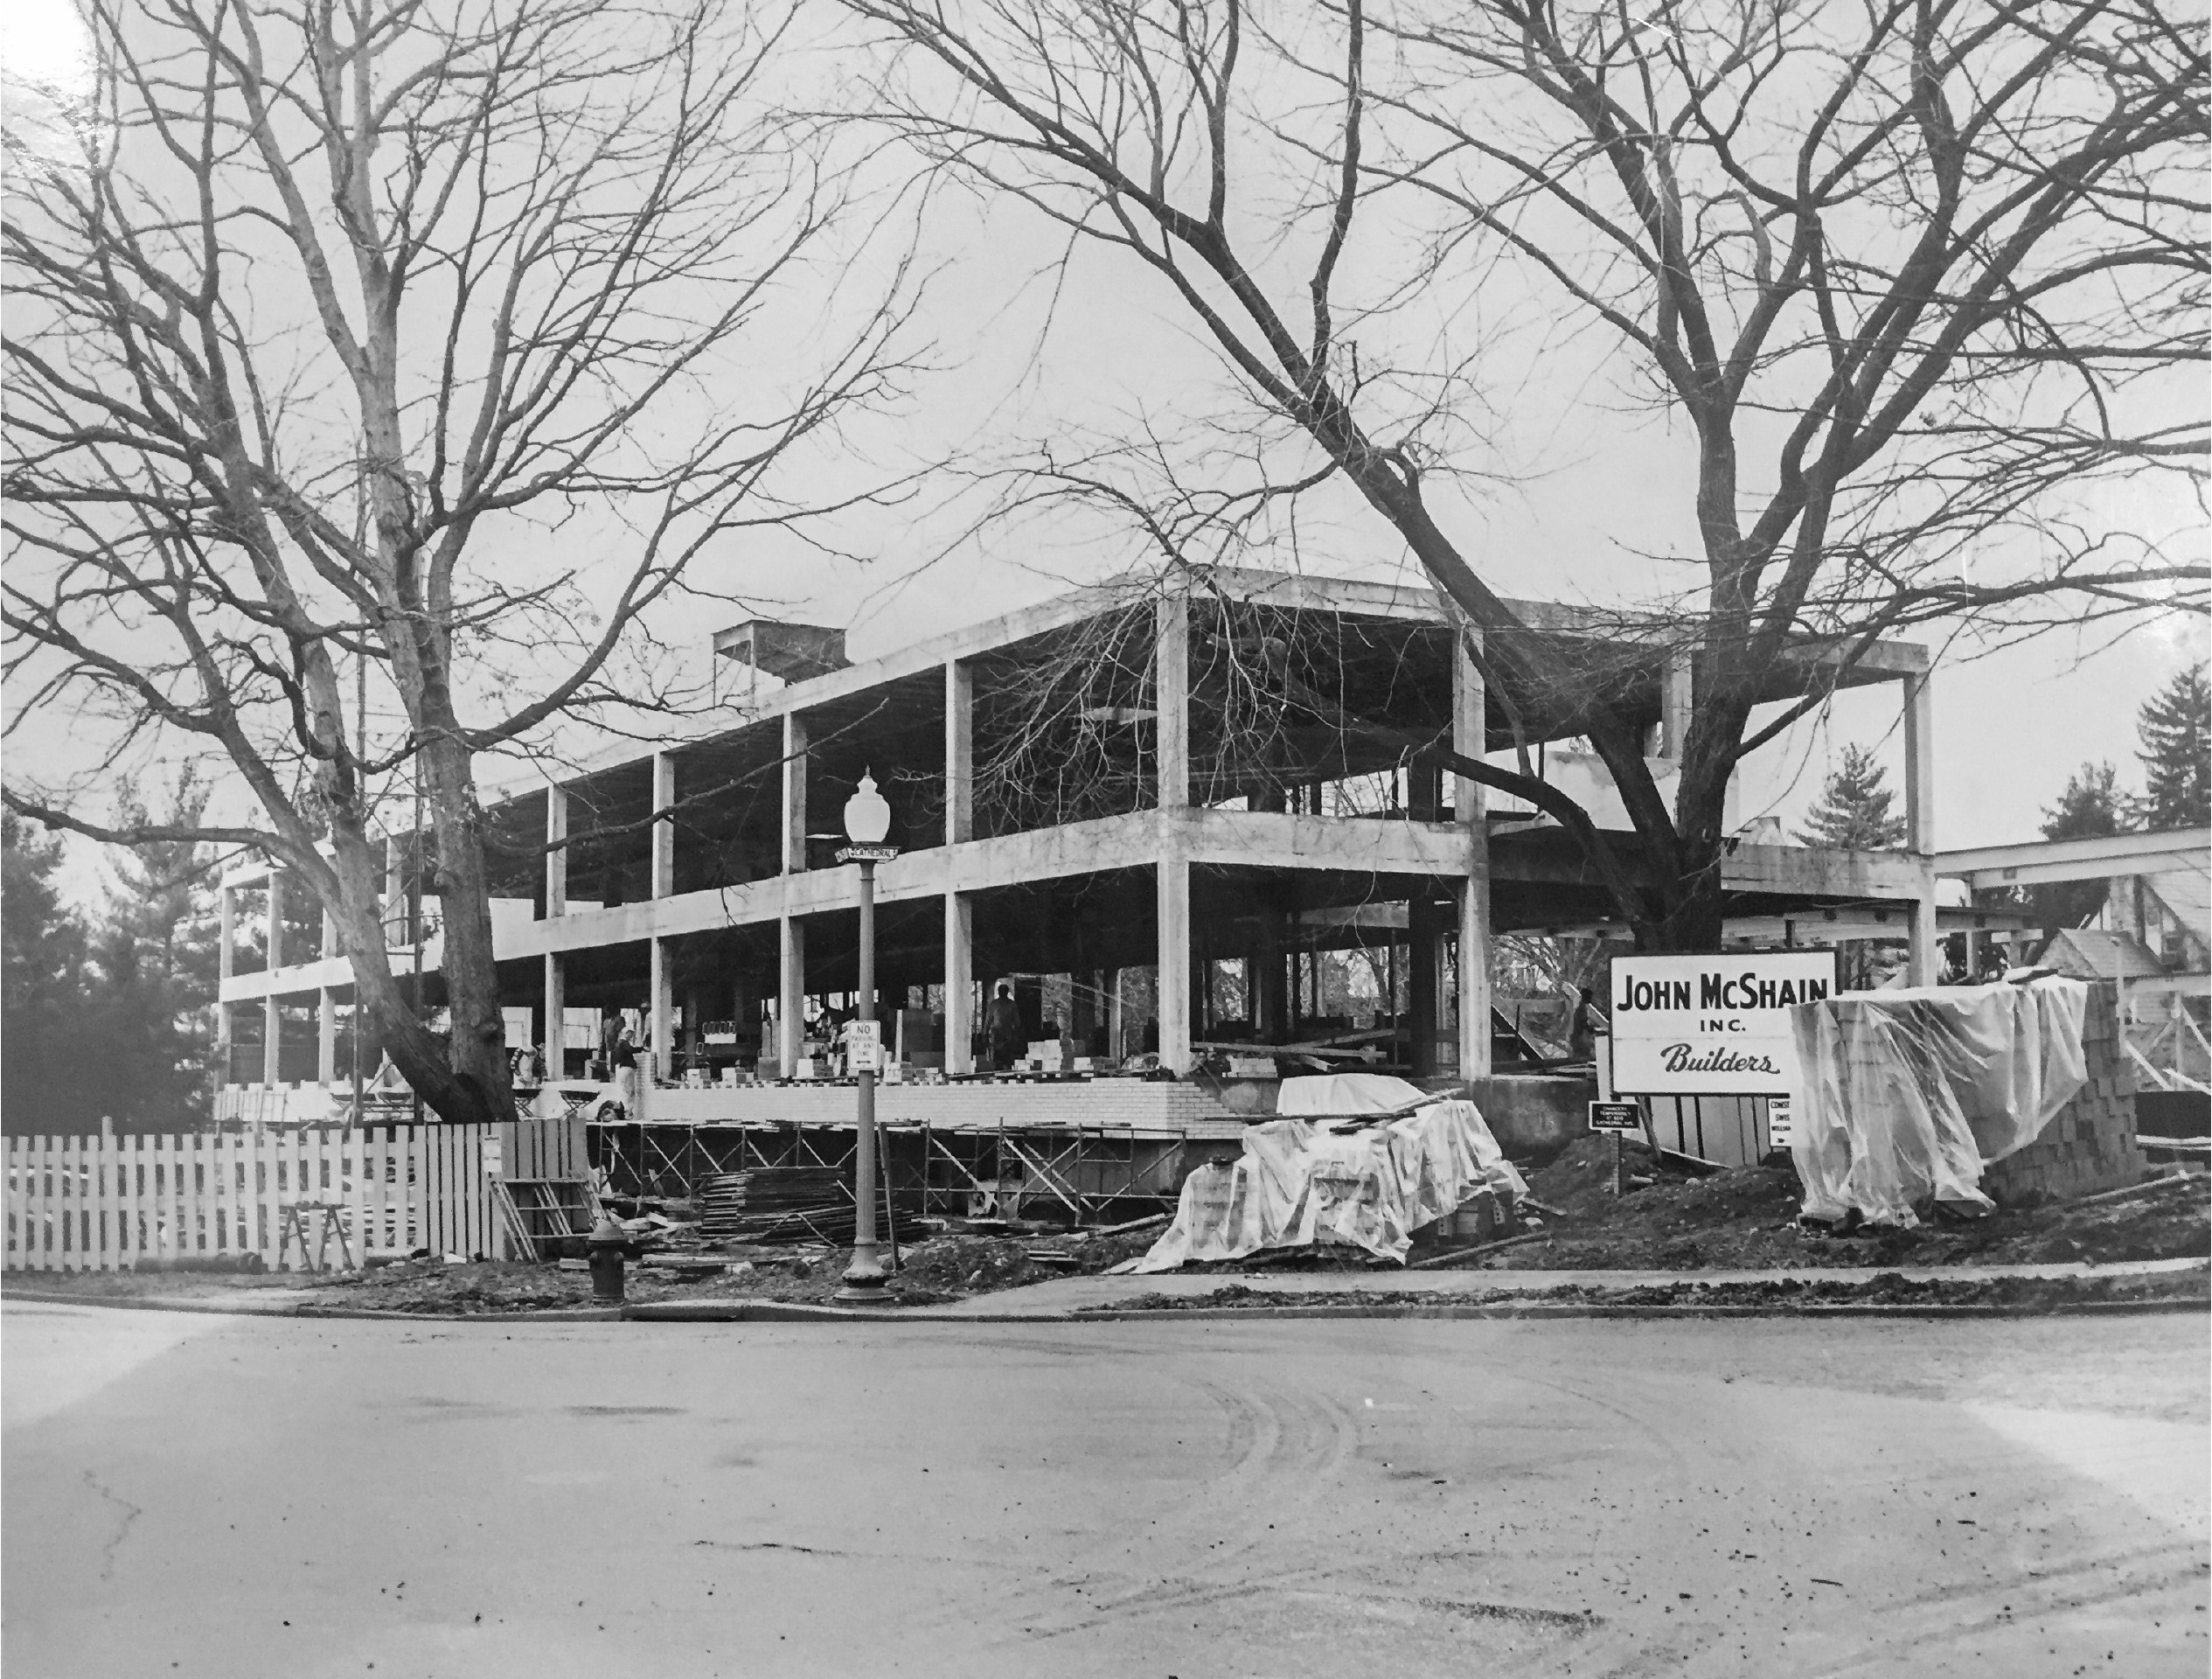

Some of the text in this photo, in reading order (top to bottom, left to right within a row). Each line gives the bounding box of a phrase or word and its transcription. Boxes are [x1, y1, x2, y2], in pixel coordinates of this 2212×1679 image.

[1617, 974, 1691, 1011] JOHN
[857, 1025, 871, 1035] NO
[1701, 1020, 1746, 1032] INC.
[1660, 1043, 1780, 1074] Builders
